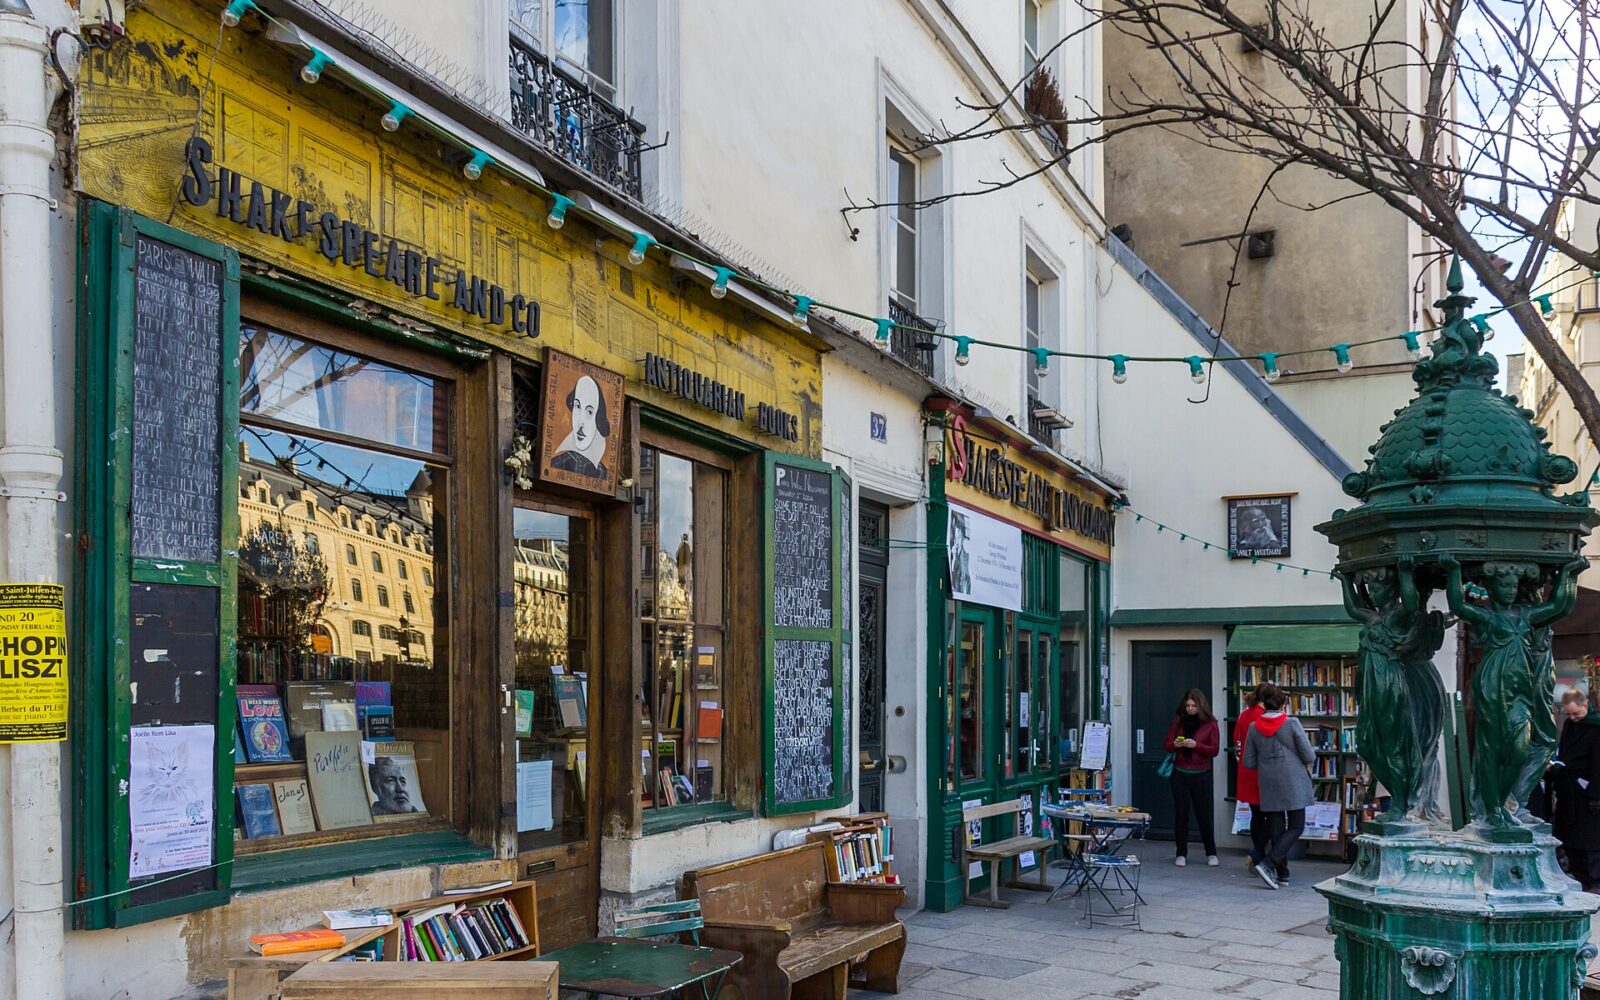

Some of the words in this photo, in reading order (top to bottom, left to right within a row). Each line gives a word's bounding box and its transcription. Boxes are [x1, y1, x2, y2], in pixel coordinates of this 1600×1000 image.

[183, 136, 440, 300] SHAKESPEARE
[454, 270, 504, 325] AND
[512, 294, 540, 338] CO
[137, 239, 170, 271] PARIS
[189, 257, 219, 288] WALL
[137, 265, 188, 293] NEWSPAPER
[193, 281, 219, 303] 1999
[136, 297, 168, 320] WROTE
[171, 307, 197, 330] ABOUT
[202, 317, 218, 335] THE
[136, 328, 155, 348] THE
[137, 313, 174, 336] LITTLE
[209, 336, 219, 350] OF
[133, 361, 172, 383] WINDOWS
[174, 370, 200, 390] FILLED
[201, 378, 219, 395] WITH
[196, 361, 217, 380] SHOP
[133, 376, 155, 394] OLD
[162, 383, 195, 404] BOOKS
[197, 391, 215, 408] AND
[549, 372, 557, 395] STILL
[645, 352, 745, 421] ANTIQUARIAN
[759, 401, 798, 443] BOOKS
[547, 397, 556, 420] ALIVE
[207, 420, 218, 436] TO
[545, 424, 554, 441] ART
[873, 416, 884, 440] 37
[196, 433, 215, 450] THE
[133, 452, 147, 470] BE
[609, 452, 616, 462] TO
[950, 415, 1049, 519] SHAKESPEARE
[133, 484, 195, 507] DIFFERENT
[198, 495, 215, 511] TO
[774, 498, 789, 511] SOME
[791, 500, 807, 513] PEOPLE
[132, 499, 176, 519] WORLDLY
[181, 506, 217, 524] SUCCESS
[774, 508, 785, 520] THE
[133, 513, 167, 531] BESIDE
[171, 519, 188, 534] HIM
[191, 521, 214, 536] LIES
[133, 528, 139, 541] A
[142, 529, 162, 544] DOG
[166, 532, 179, 545] OR
[139, 542, 155, 556] CAT
[167, 545, 188, 559] WISH
[817, 547, 829, 559] THE
[1254, 548, 1281, 556] WHITMAN
[815, 558, 827, 570] CAN
[774, 586, 786, 597] AND
[788, 587, 811, 599] INSTEAD
[20, 612, 35, 622] 20
[774, 615, 787, 626] LIKE
[794, 616, 830, 628] FRUSTRATED
[0, 636, 66, 656] HOPIN
[0, 658, 62, 679] LISZT
[241, 699, 281, 717] LOVE
[278, 783, 305, 803] Janus
